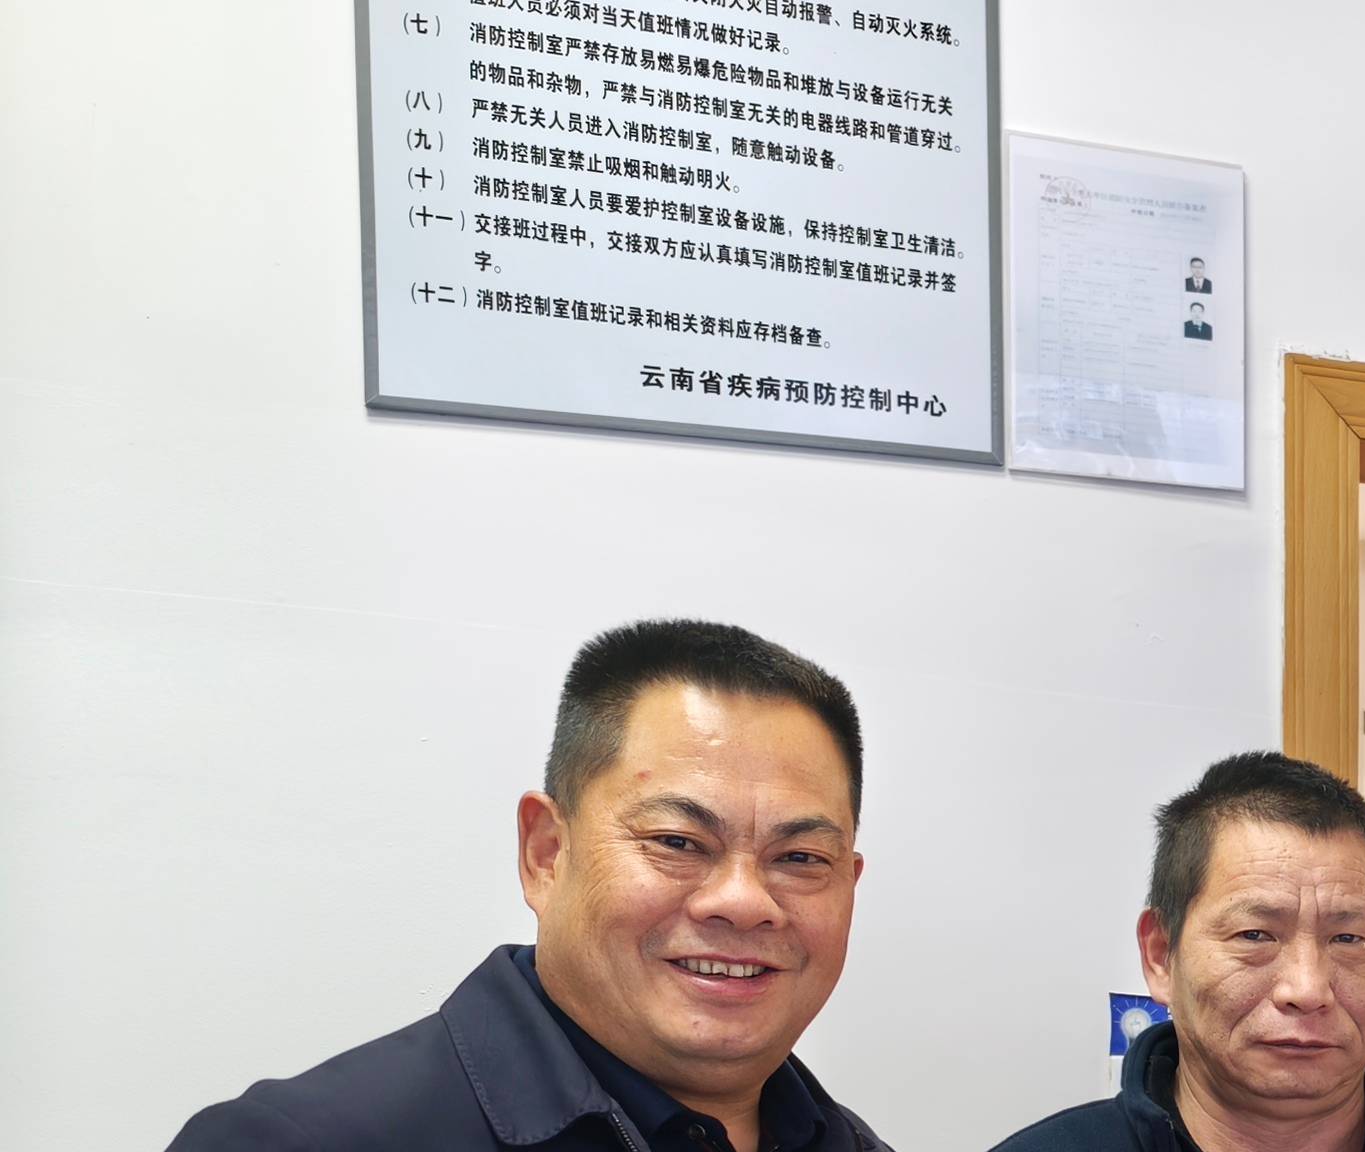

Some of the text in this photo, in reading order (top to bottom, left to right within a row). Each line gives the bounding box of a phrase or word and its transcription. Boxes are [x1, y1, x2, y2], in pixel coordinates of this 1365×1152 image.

[470, 0, 790, 55] 人员必须对当天值班情况做好记录。
[470, 22, 953, 116] 消防控制室严禁存放易燃易爆危险物品和堆放与设备运行无关
[470, 60, 961, 152] 的物品和杂物，严禁与消防控制室无关的电器线路和管道穿过。
[472, 98, 844, 171] 严禁无关人员进入消防控制室，随意触动设备。
[473, 136, 741, 193] 消防控制室禁止吸烟和触动明火。
[474, 174, 964, 259] 消防控制室人员要爱护控制室设备设施，保持控制室卫生清洁。
[474, 212, 957, 292] 交接班过程中，交接双方应认真填写消防控制室值班记录并签
[474, 250, 502, 275] 字。
[476, 288, 831, 350] 消防控制室值班记录和相关资料应存档备查。
[640, 364, 948, 418] 云南省疾病预防控制中心
